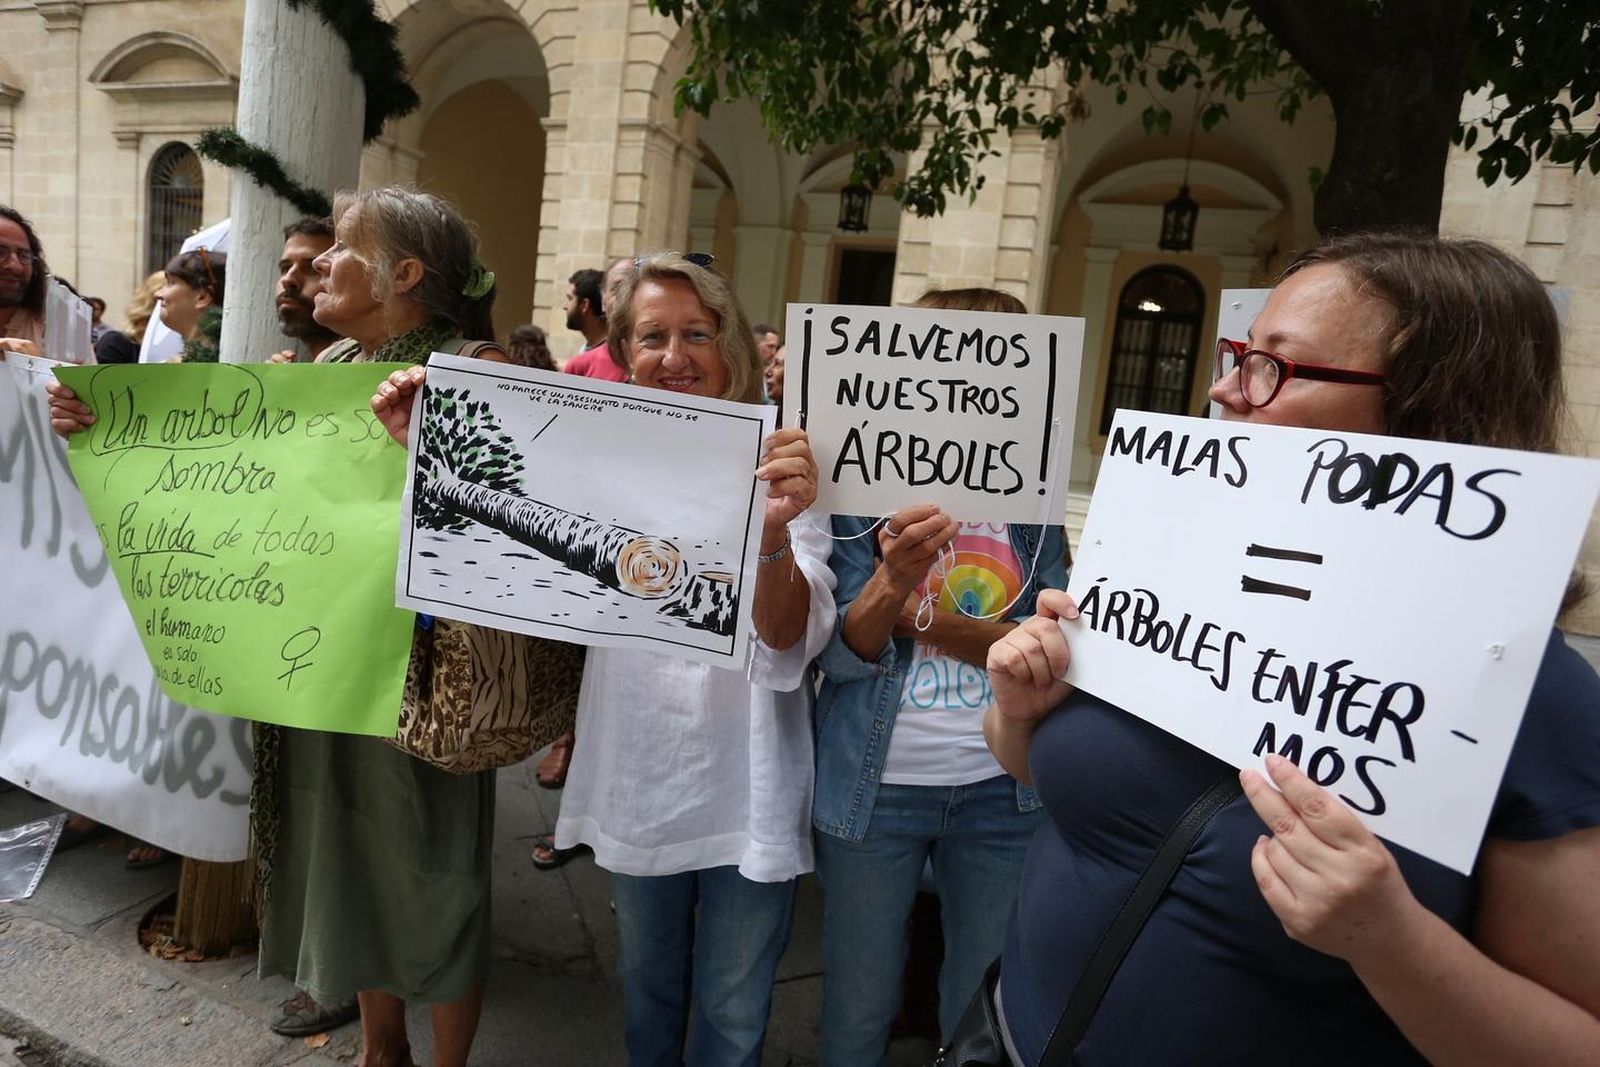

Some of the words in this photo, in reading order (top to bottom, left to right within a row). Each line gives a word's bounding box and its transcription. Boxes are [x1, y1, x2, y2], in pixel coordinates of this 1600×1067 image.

[826, 316, 1030, 369] SALVEMOS
[103, 384, 149, 448] Un
[161, 388, 250, 444] arbol
[306, 412, 339, 438] es
[497, 383, 510, 391] NO
[511, 385, 548, 397] PARECE
[567, 393, 619, 408] ASESINATO
[622, 402, 662, 415] PORQUE
[562, 400, 604, 412] SANGRE
[836, 373, 1020, 419] NUESTROS
[144, 453, 277, 495] sombra
[832, 420, 1024, 496] ÁRBOLES
[1110, 426, 1251, 488] MALAS
[1300, 438, 1522, 541] PODAS
[146, 508, 197, 552] vida
[213, 518, 243, 550] de
[256, 508, 335, 556] todas
[146, 608, 156, 637] el
[161, 607, 226, 644] humano
[187, 666, 223, 696] ellas
